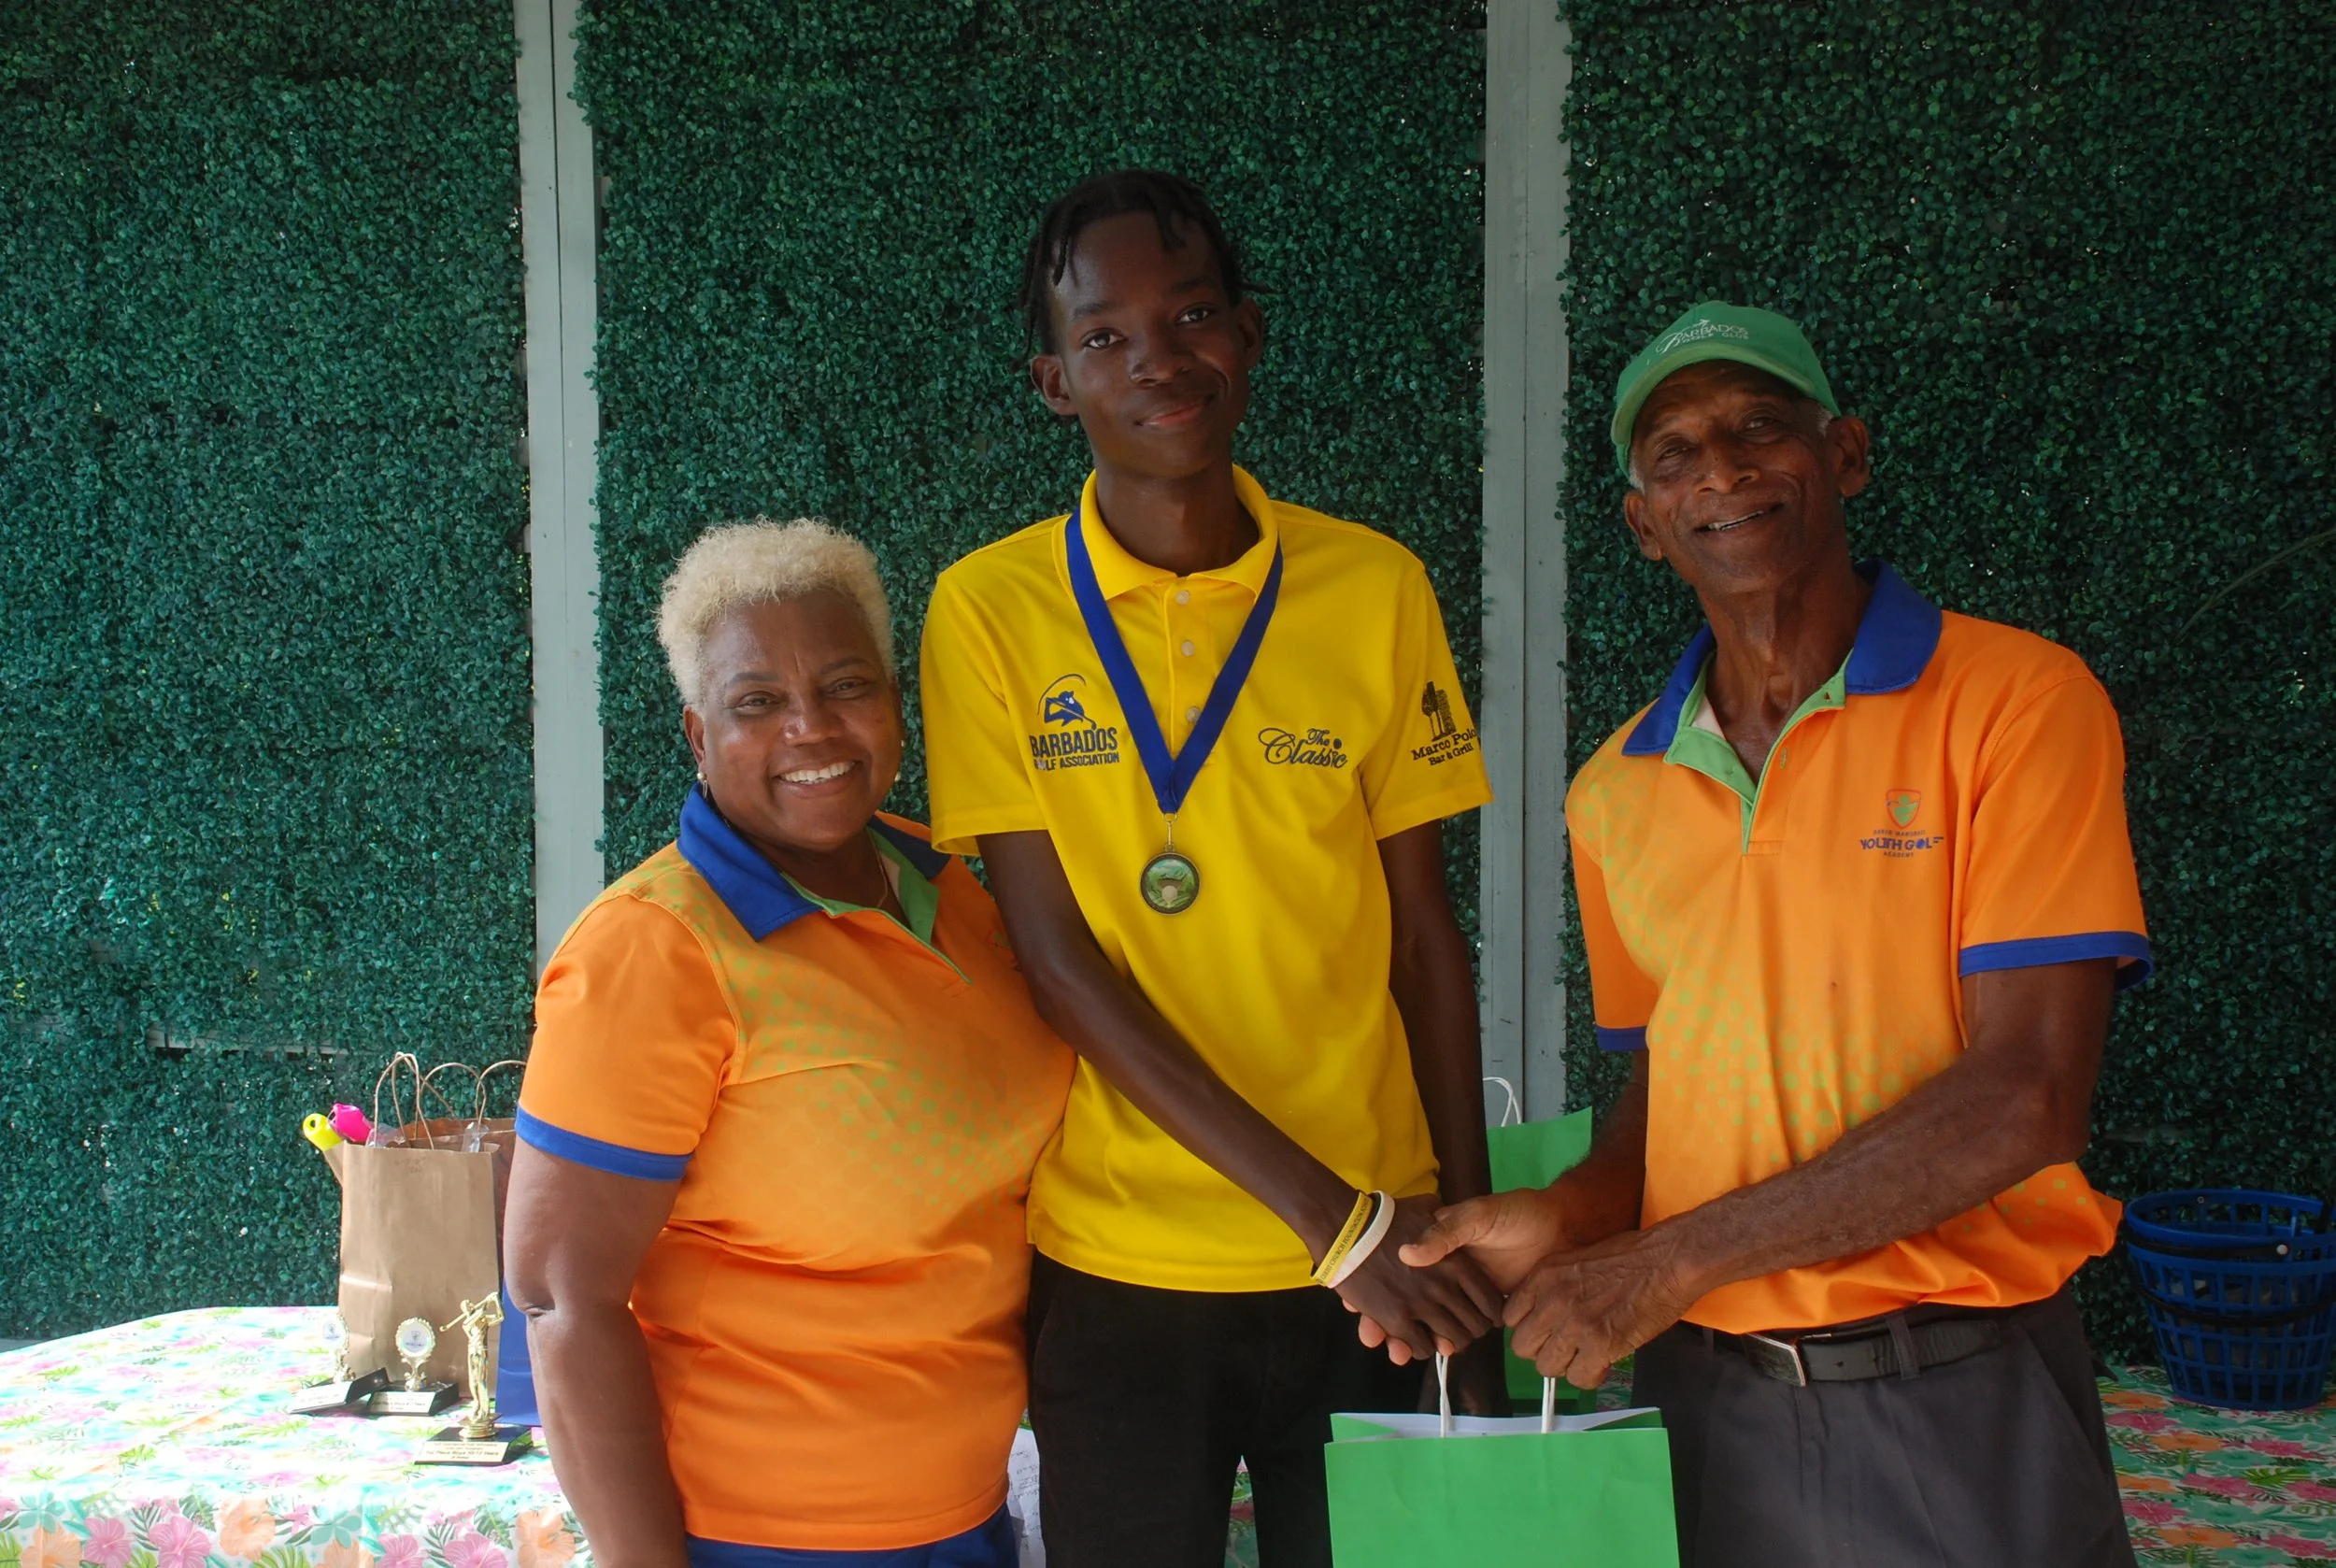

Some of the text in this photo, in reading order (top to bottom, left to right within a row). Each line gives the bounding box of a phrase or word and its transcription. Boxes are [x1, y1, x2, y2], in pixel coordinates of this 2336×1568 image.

[1656, 322, 1748, 355] BARBADOS
[1029, 727, 1118, 758] BARBADOS
[1258, 727, 1348, 769] Classic
[1306, 728, 1331, 746] The
[1411, 728, 1477, 761] Marco Polo
[1060, 752, 1120, 769] ASSOCIATION
[1428, 743, 1474, 766] Bar & Grill
[1859, 835, 1944, 850] YOUTH GOLF
